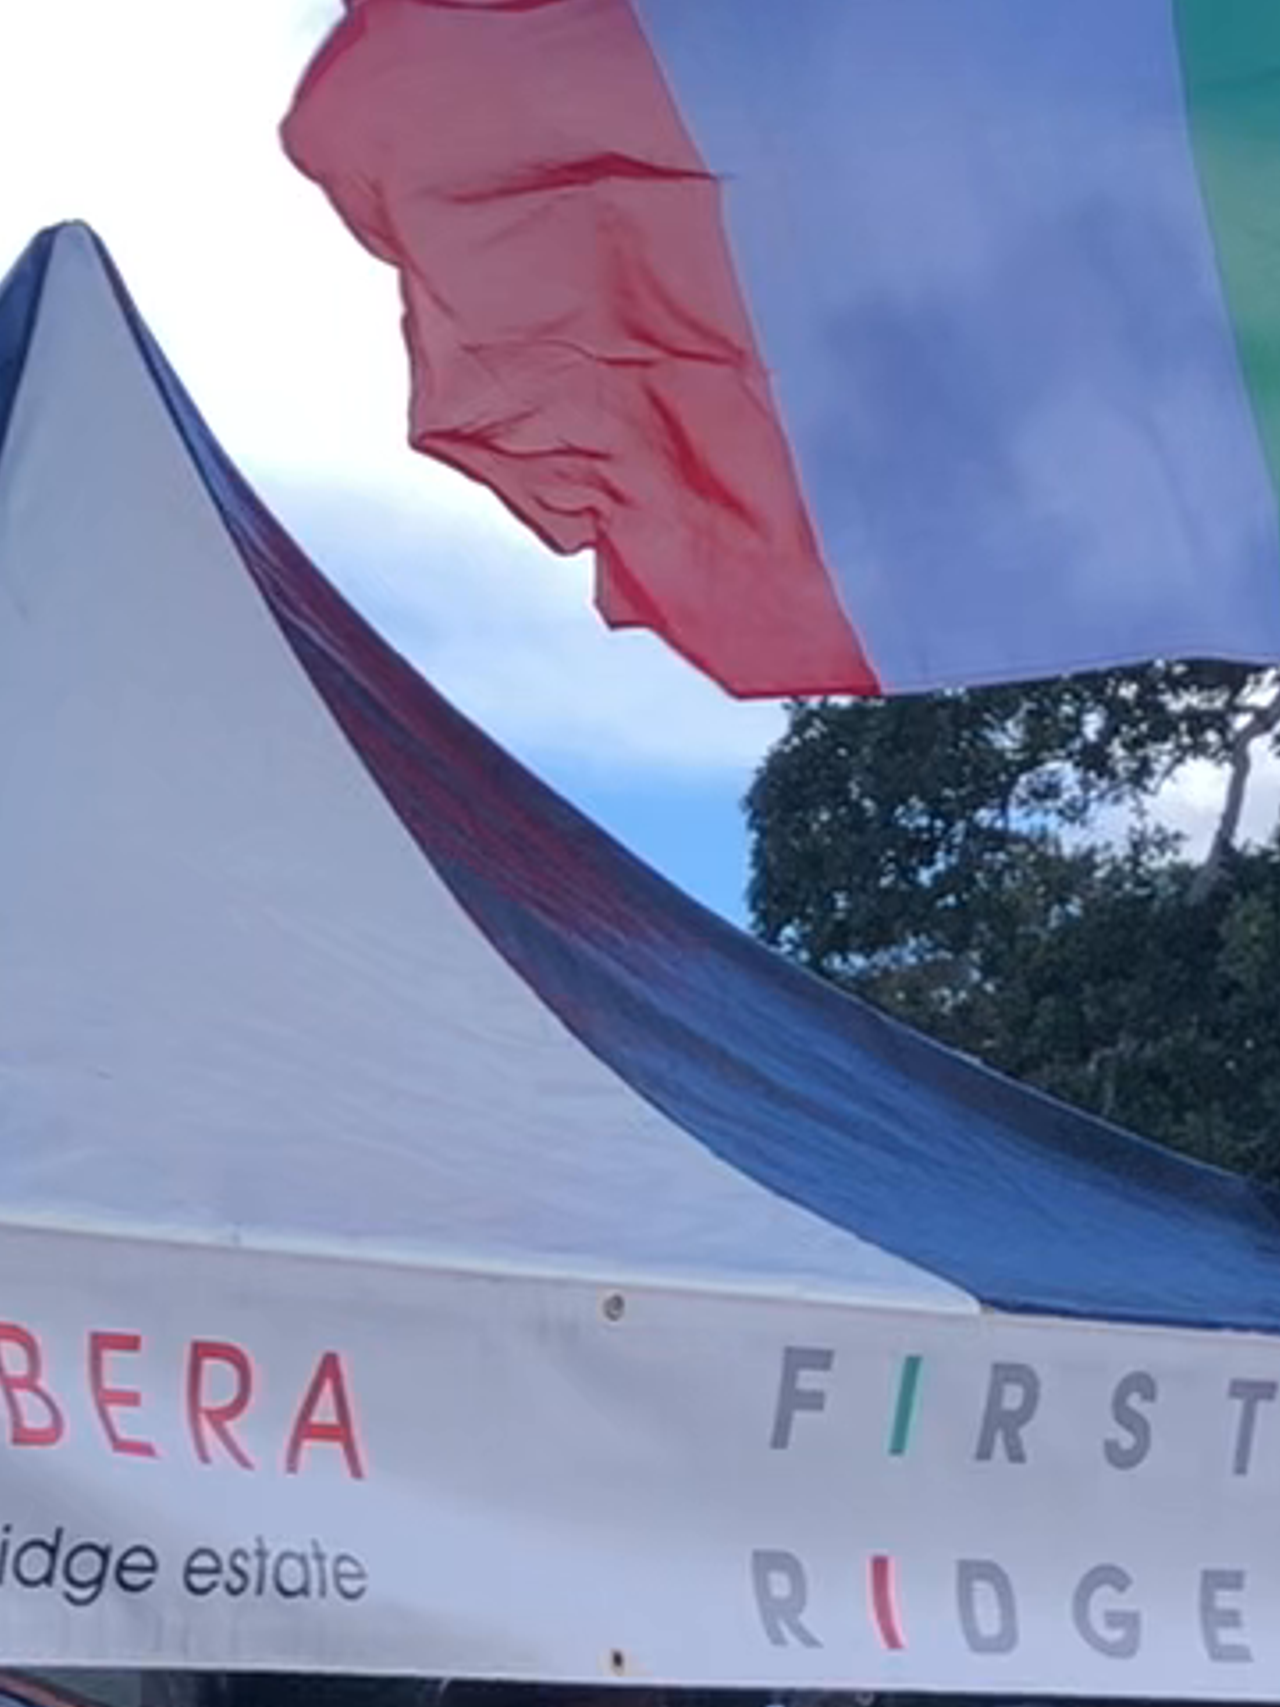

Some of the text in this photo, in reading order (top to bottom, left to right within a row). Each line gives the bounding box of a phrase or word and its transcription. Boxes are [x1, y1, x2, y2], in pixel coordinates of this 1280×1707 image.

[769, 1347, 1279, 1476] FIRST
[182, 1533, 368, 1601] estate
[751, 1550, 1254, 1663] RIDGE
